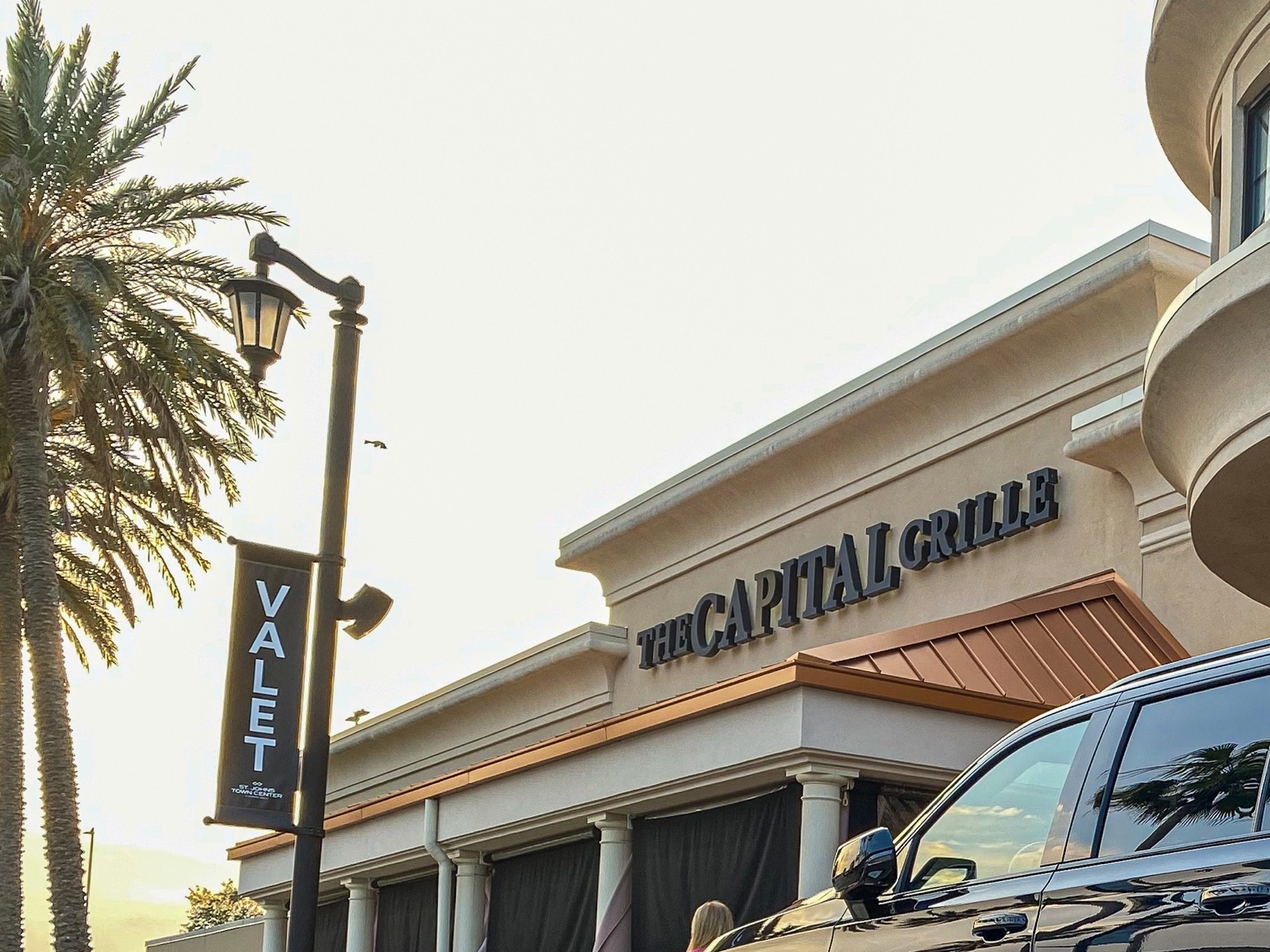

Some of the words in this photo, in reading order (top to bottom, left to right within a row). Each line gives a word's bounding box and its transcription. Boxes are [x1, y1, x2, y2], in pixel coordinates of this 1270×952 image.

[637, 613, 694, 670] THE
[691, 521, 902, 658] CAPITAL
[899, 467, 1059, 571] GRILLE
[244, 579, 291, 772] VALET
[253, 789, 283, 799] CENTER
